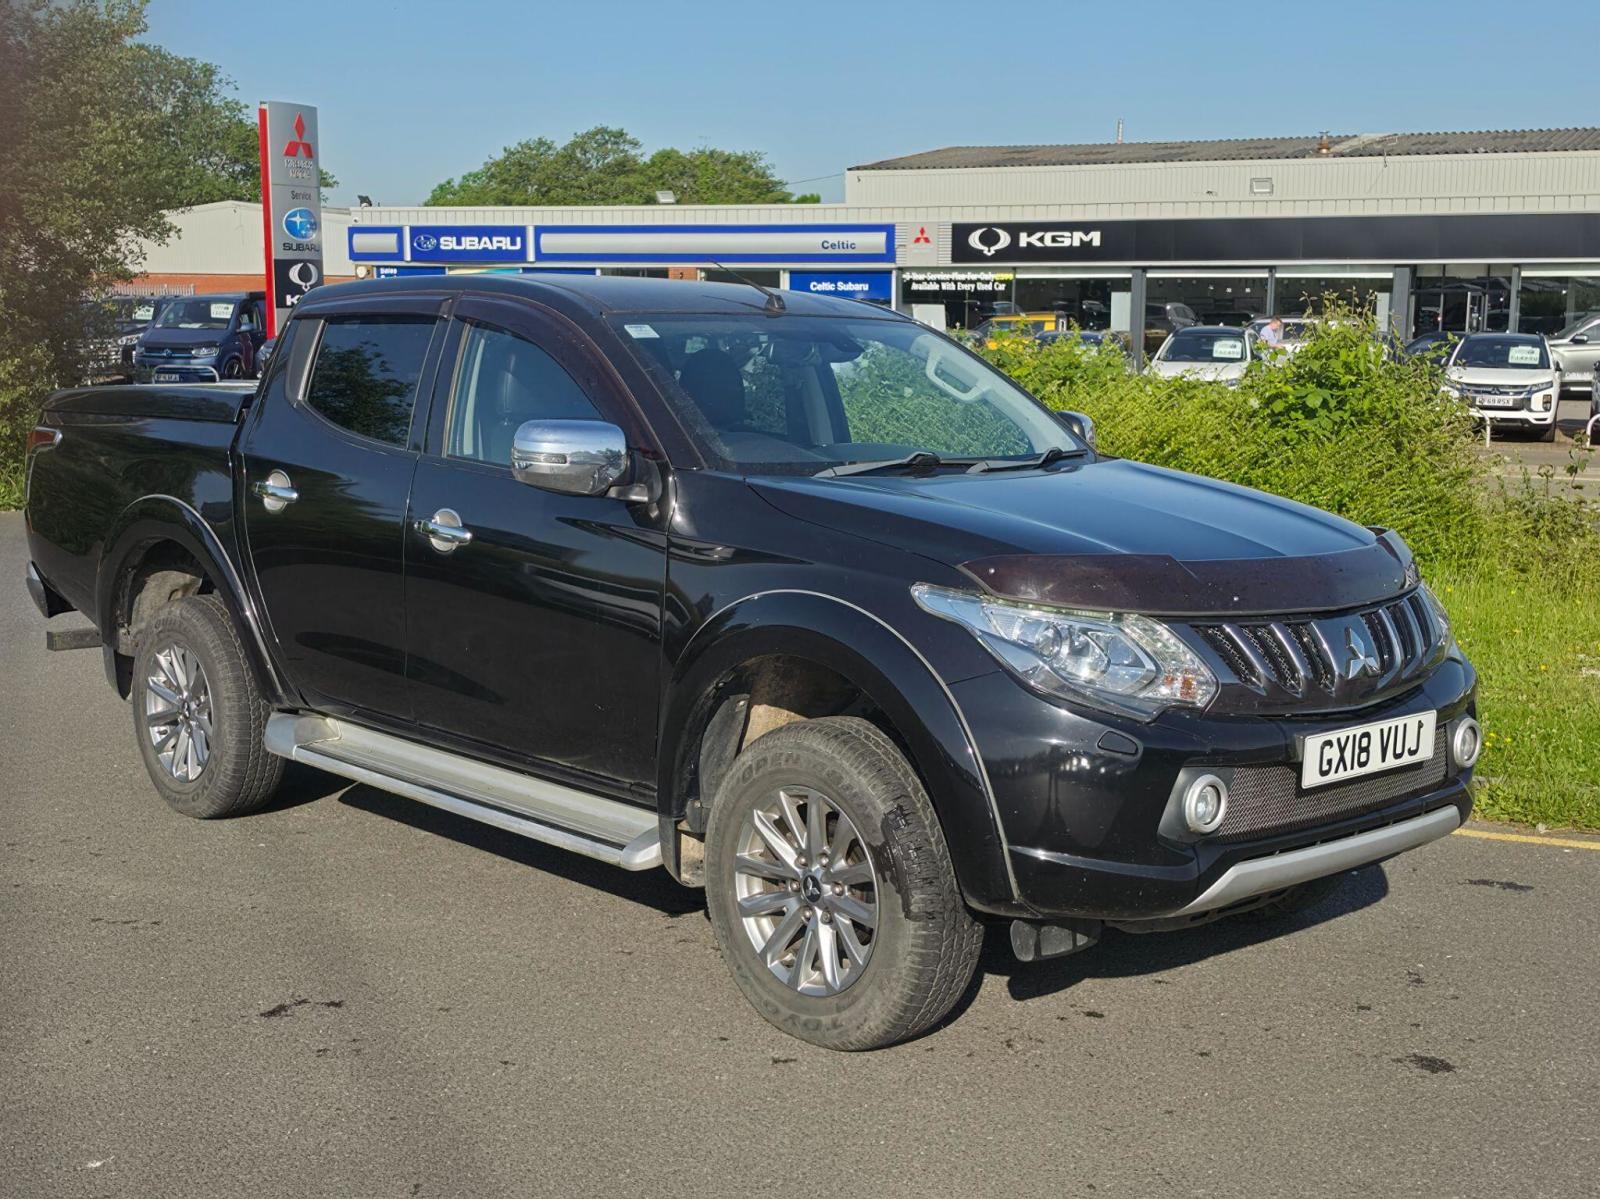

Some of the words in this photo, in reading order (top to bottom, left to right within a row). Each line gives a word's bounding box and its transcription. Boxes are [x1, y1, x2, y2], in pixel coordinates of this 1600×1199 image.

[440, 236, 521, 250] SUBARU
[821, 240, 856, 250] Celtic
[1019, 231, 1101, 247] KGM
[810, 281, 835, 291] Celtic
[837, 281, 869, 291] Subaru
[911, 281, 939, 290] Available
[941, 281, 956, 290] With
[957, 281, 976, 292] Every
[977, 281, 993, 290] Used
[994, 281, 1006, 290] Car
[1318, 731, 1372, 777] GX18
[1379, 720, 1424, 764] VUJ
